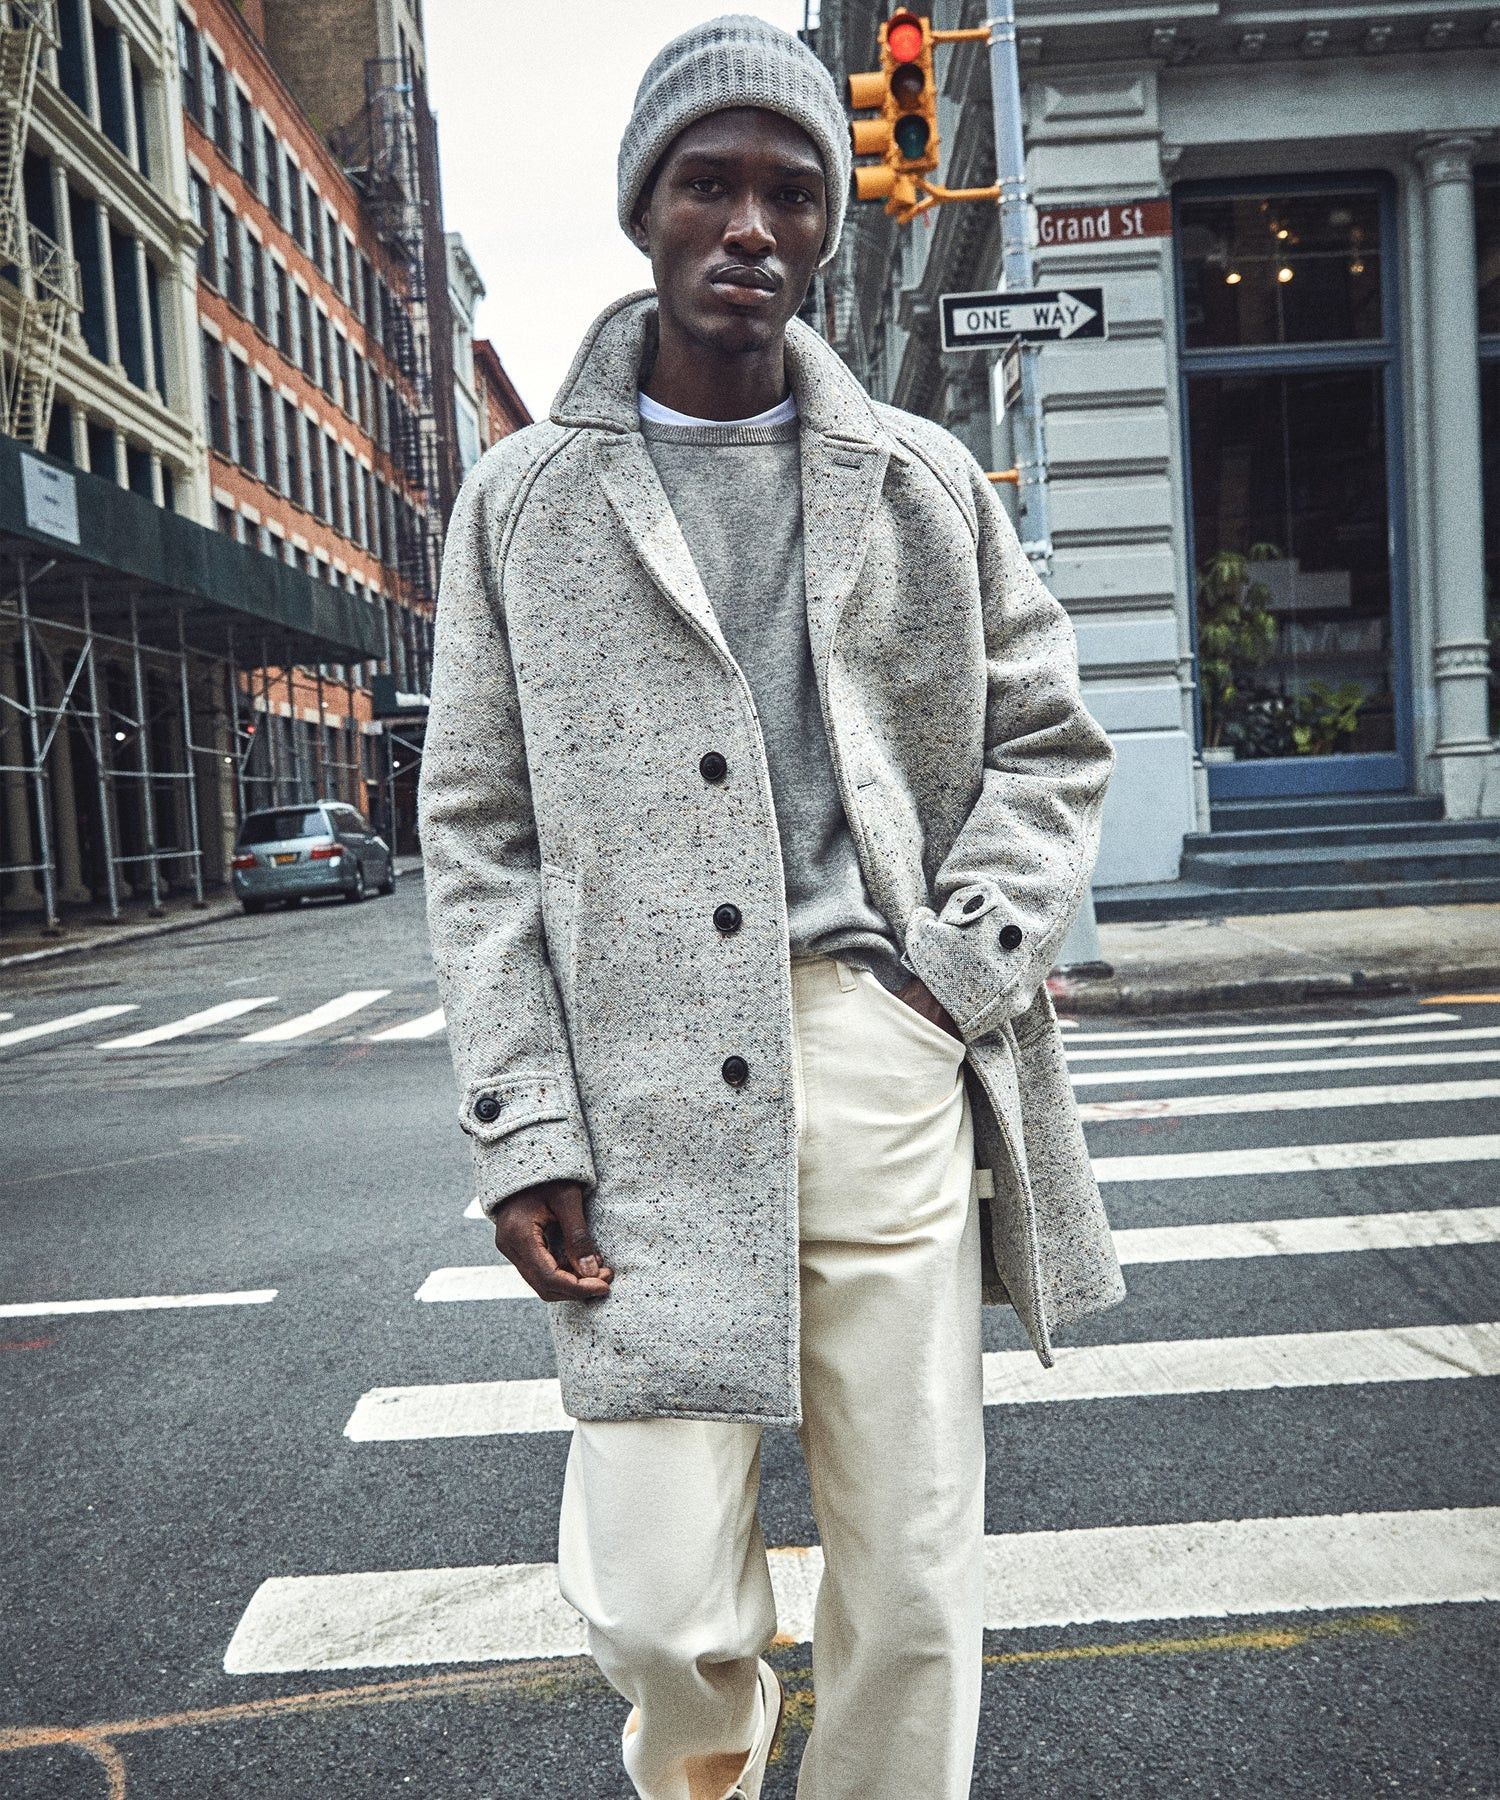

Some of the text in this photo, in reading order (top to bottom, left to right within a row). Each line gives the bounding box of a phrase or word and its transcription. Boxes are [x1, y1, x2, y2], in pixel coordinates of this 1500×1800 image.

[1040, 207, 1144, 243] Grand St
[966, 305, 1079, 331] ONE WAY
